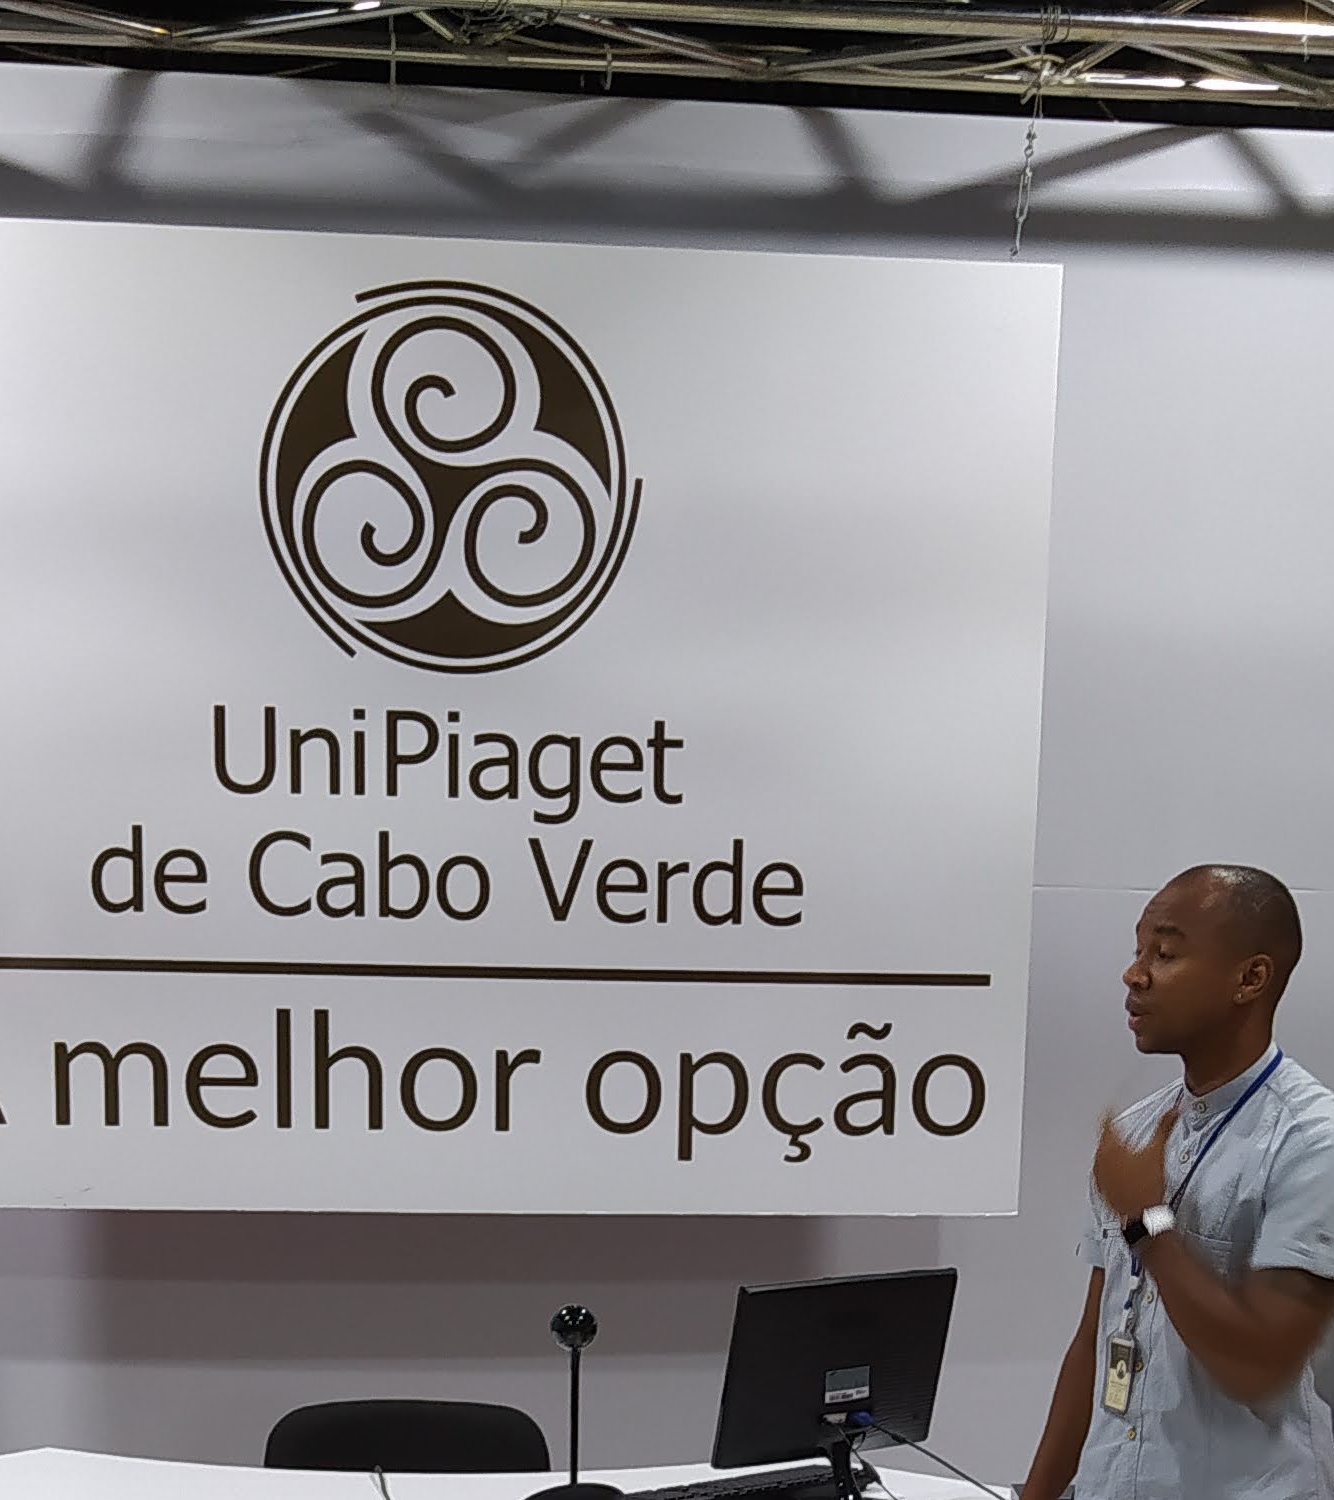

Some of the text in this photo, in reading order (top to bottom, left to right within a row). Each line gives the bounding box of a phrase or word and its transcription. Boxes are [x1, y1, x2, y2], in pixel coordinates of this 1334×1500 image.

[213, 704, 684, 824] UniPiaget
[91, 824, 804, 927] de Cabo Verde
[54, 1008, 542, 1132] melhor
[585, 1022, 986, 1163] opção
